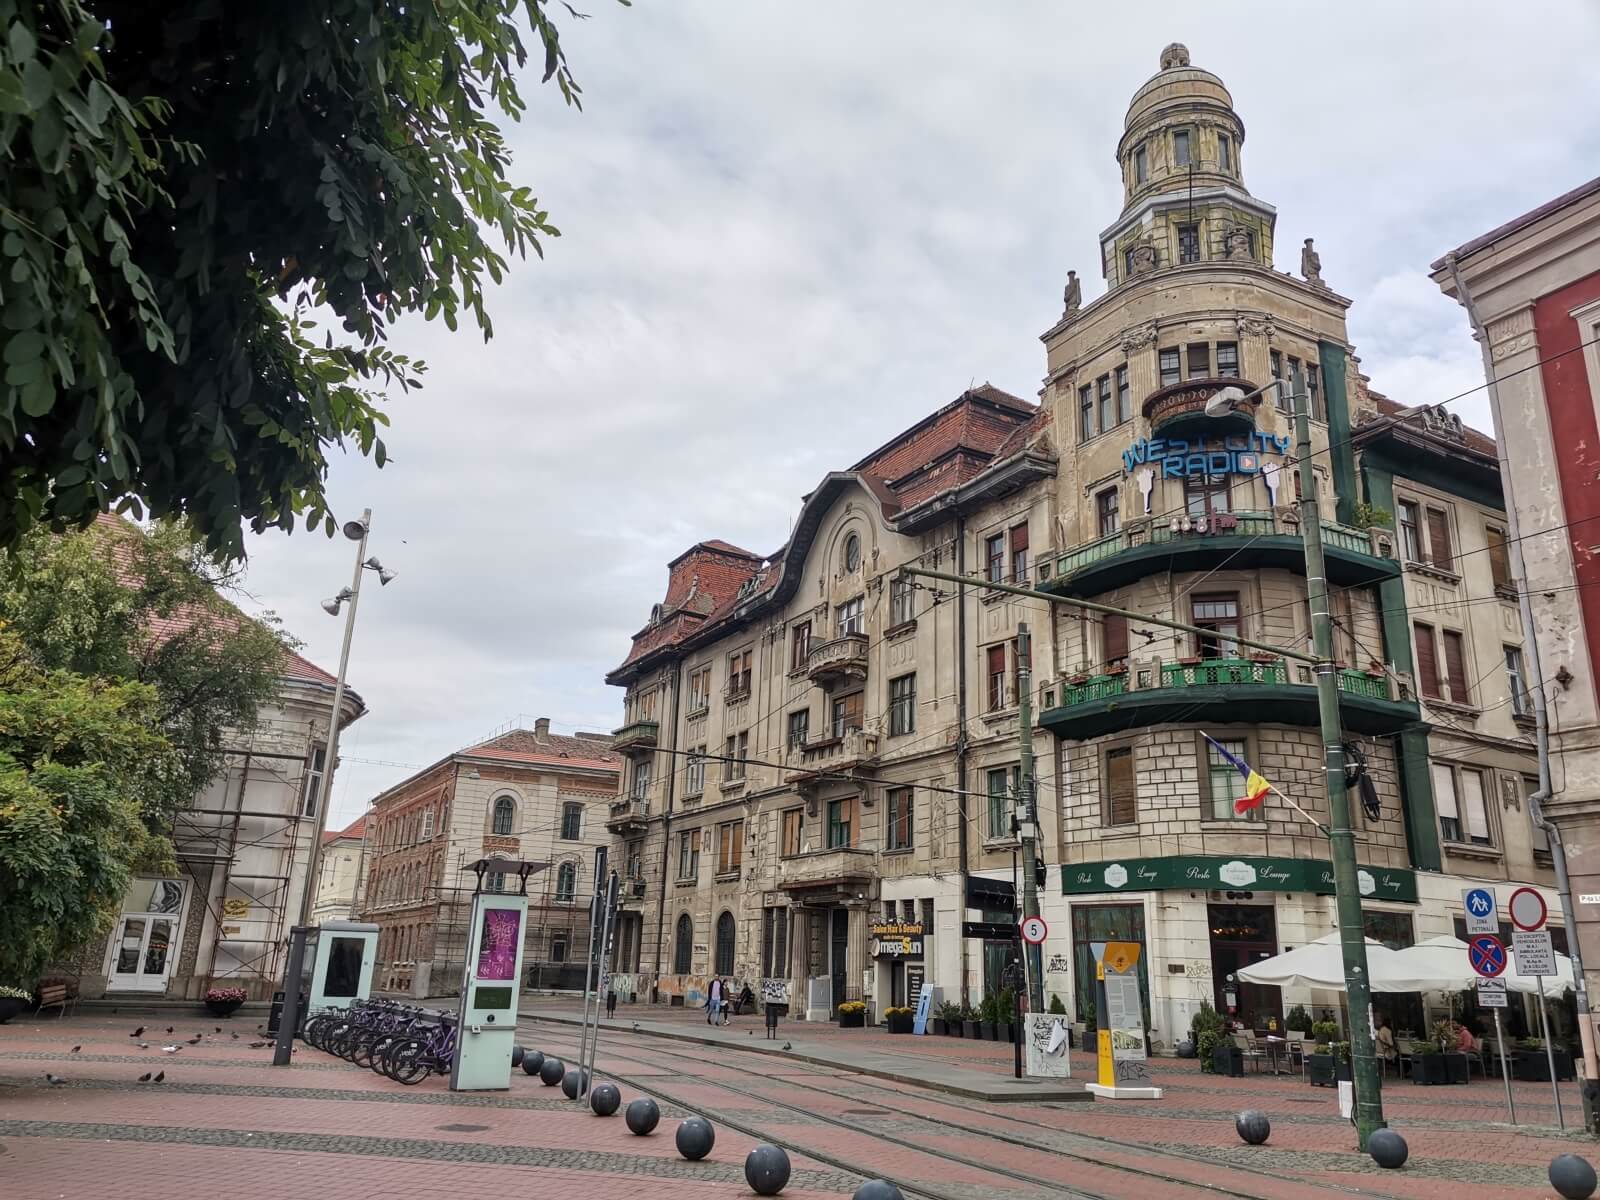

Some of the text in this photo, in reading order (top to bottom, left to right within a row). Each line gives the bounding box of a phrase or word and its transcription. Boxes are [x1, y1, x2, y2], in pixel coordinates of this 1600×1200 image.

[1122, 431, 1291, 472] WEST CITY
[1164, 451, 1259, 480] RADIO
[1185, 866, 1210, 880] Resto
[1259, 865, 1291, 884] Lounge
[888, 923, 898, 934] Hair
[903, 923, 923, 935] Beauty
[1031, 924, 1038, 936] 5
